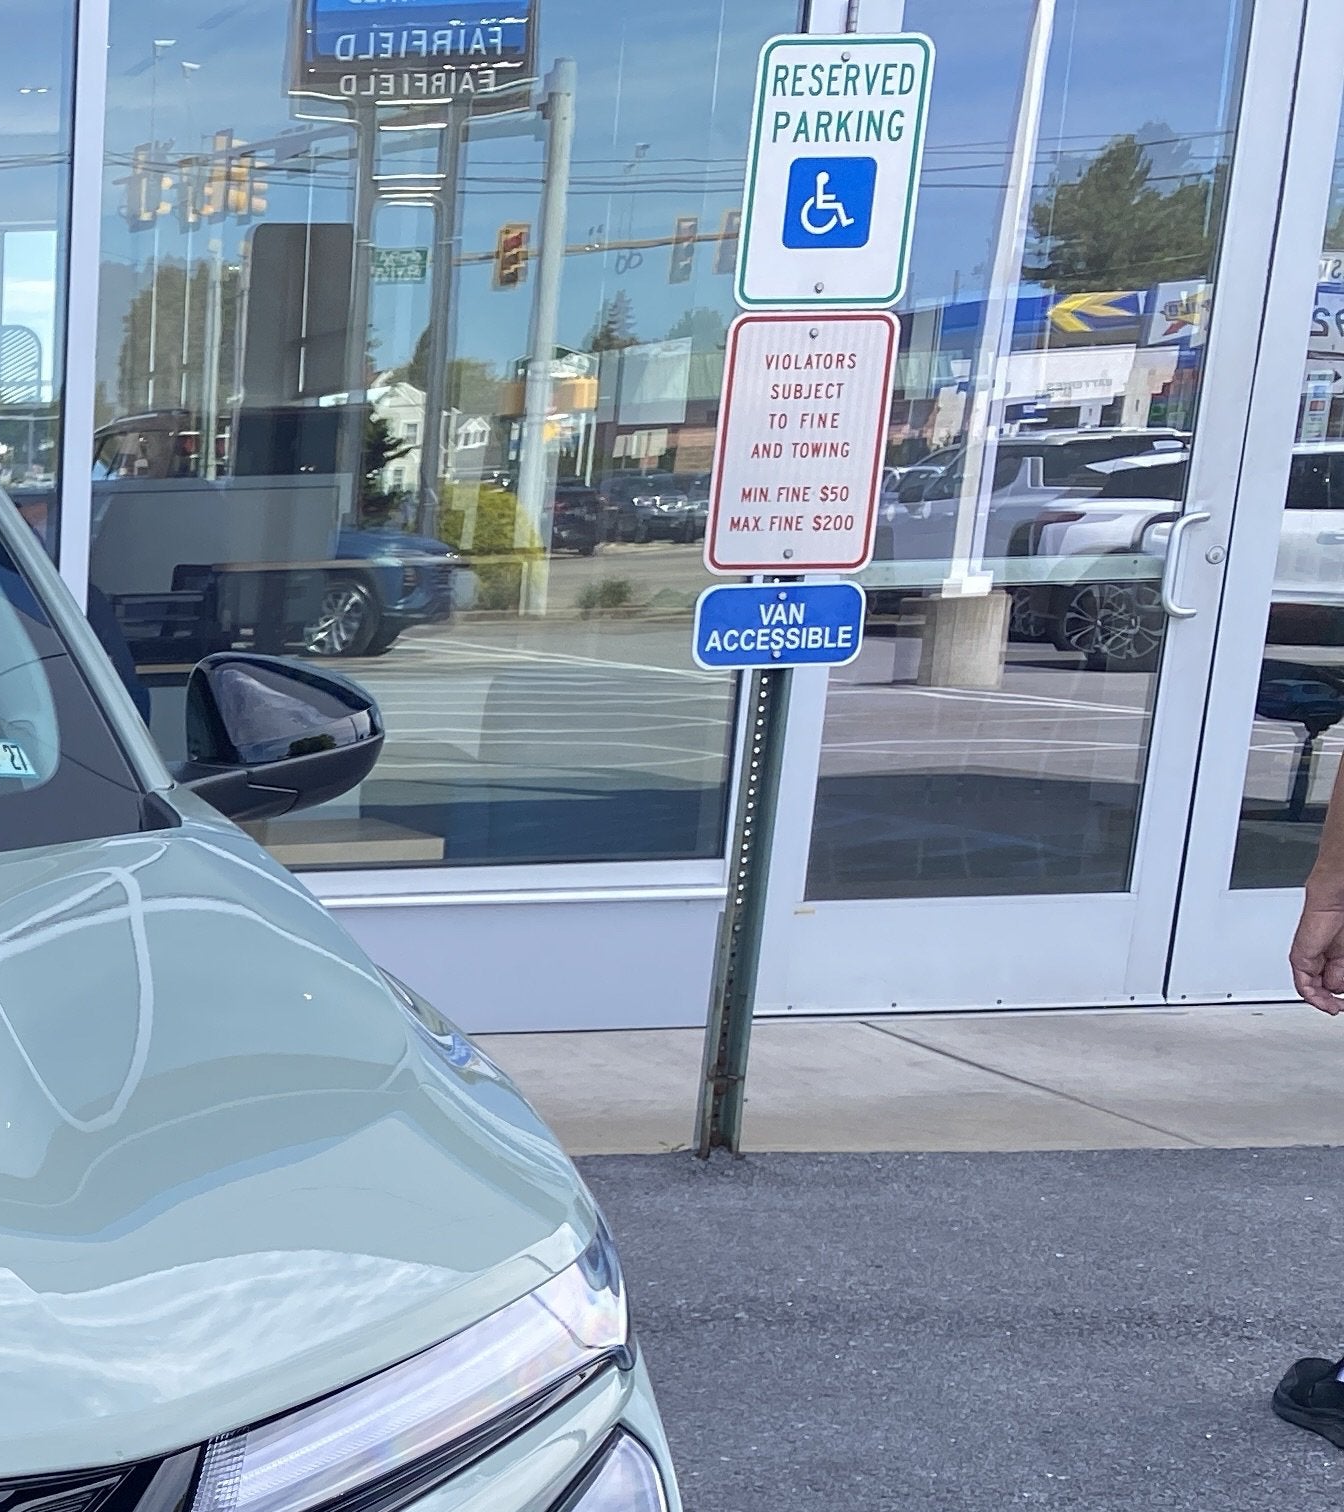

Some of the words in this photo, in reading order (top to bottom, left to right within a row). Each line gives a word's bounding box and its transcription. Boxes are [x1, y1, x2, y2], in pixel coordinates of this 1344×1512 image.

[772, 63, 916, 97] RESERVED
[772, 110, 905, 143] PARKING
[765, 353, 858, 370] VIOLATORS
[770, 383, 845, 400] SUBJECT
[769, 413, 788, 429] TO
[800, 413, 841, 429] FINE
[751, 443, 783, 459] AND
[791, 442, 850, 458] TOWING
[777, 487, 811, 502] FINE
[819, 486, 850, 502] $50
[769, 516, 803, 532] FINE
[812, 515, 854, 532] $200
[759, 604, 805, 625] VAN
[705, 626, 853, 652] ACCESSIBLE
[2, 744, 28, 771] 27
